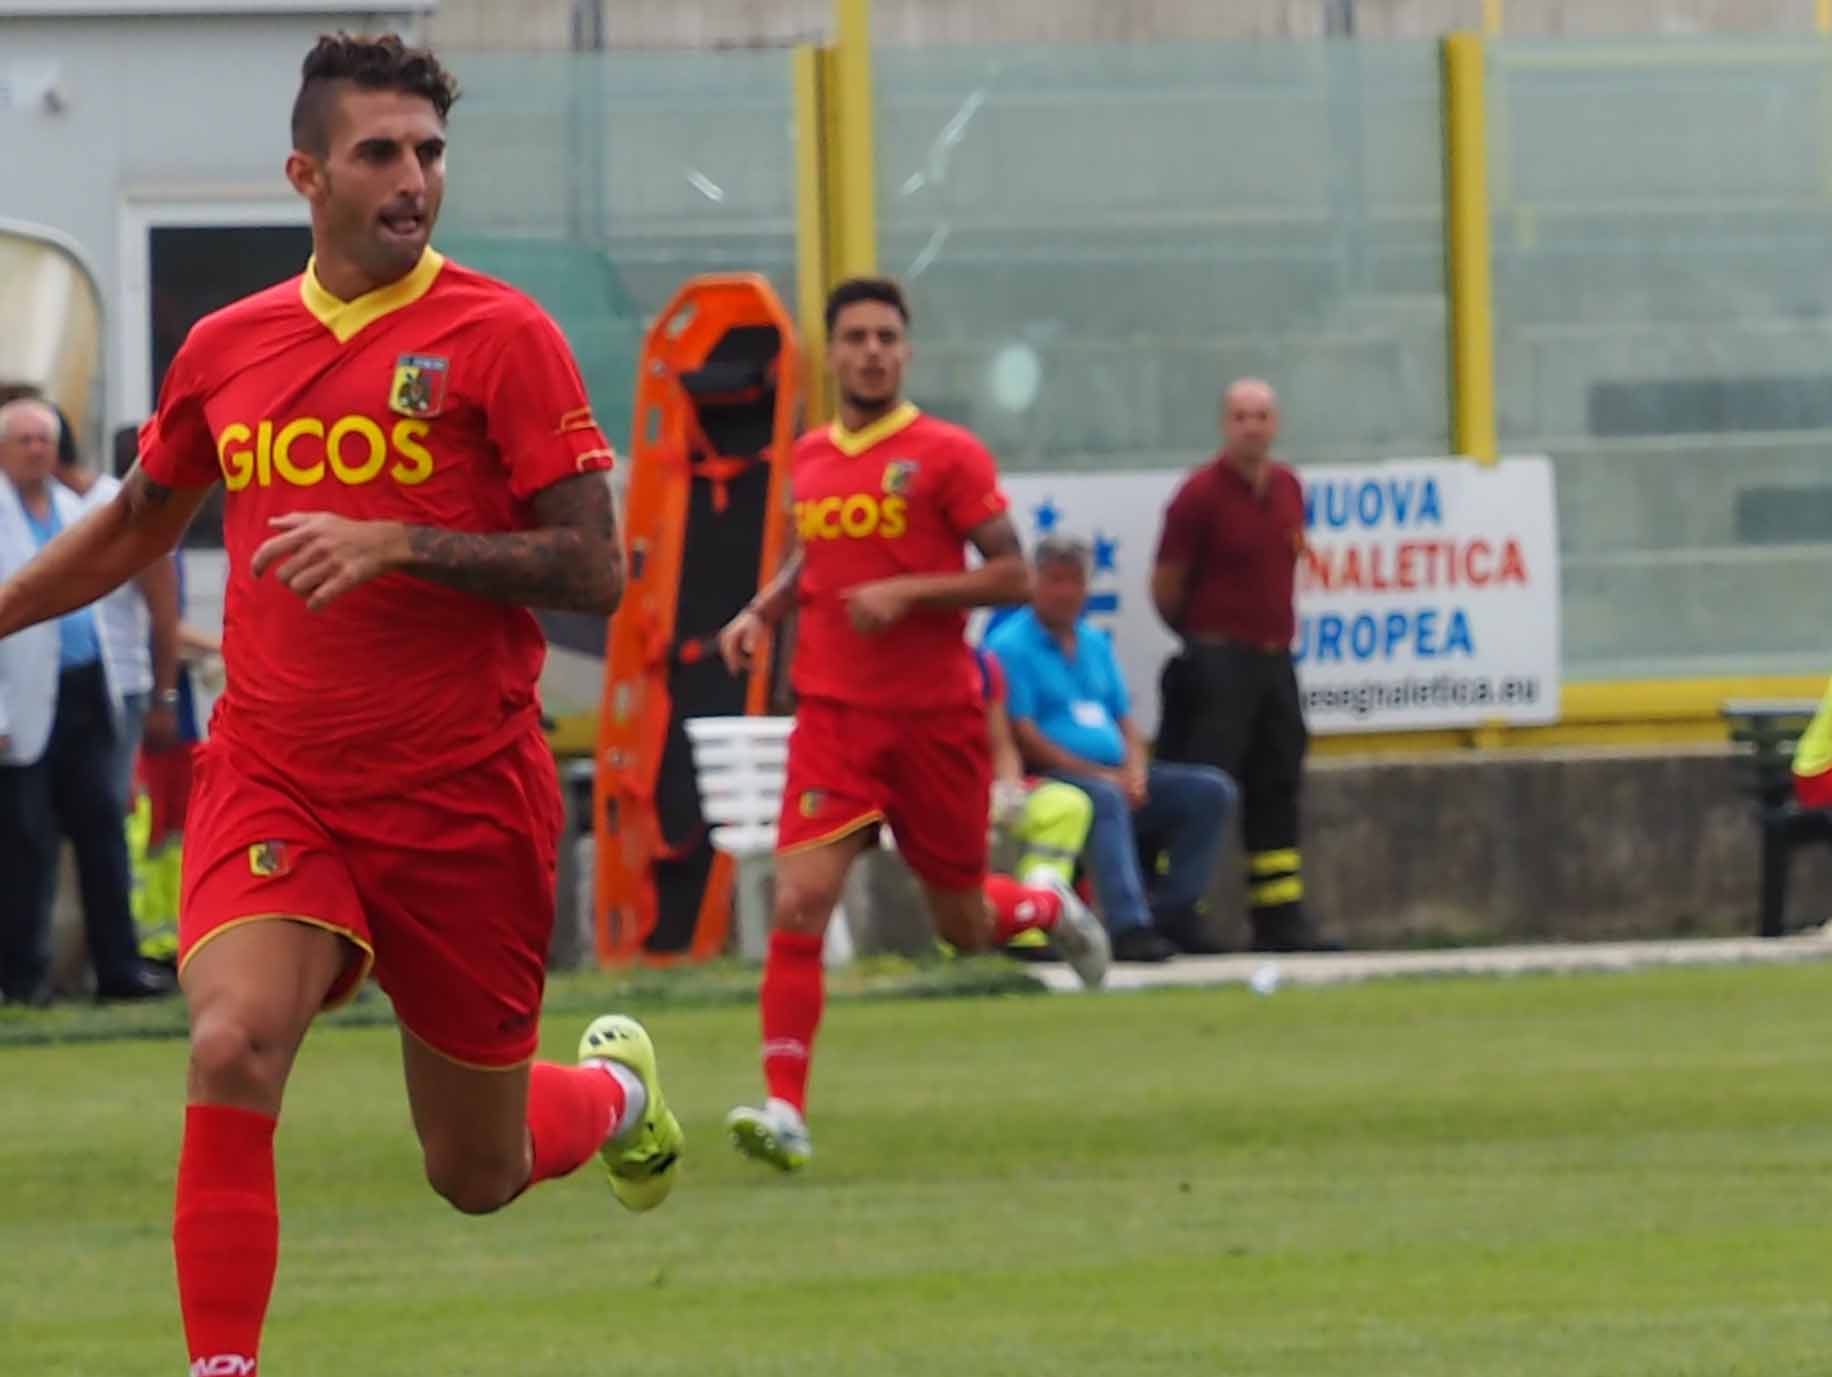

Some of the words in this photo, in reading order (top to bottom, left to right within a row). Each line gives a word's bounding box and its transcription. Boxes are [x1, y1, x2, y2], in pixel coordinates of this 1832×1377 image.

[217, 414, 434, 492] GICOS
[1300, 538, 1529, 591] NALETICA
[1290, 608, 1475, 664] UROPEA
